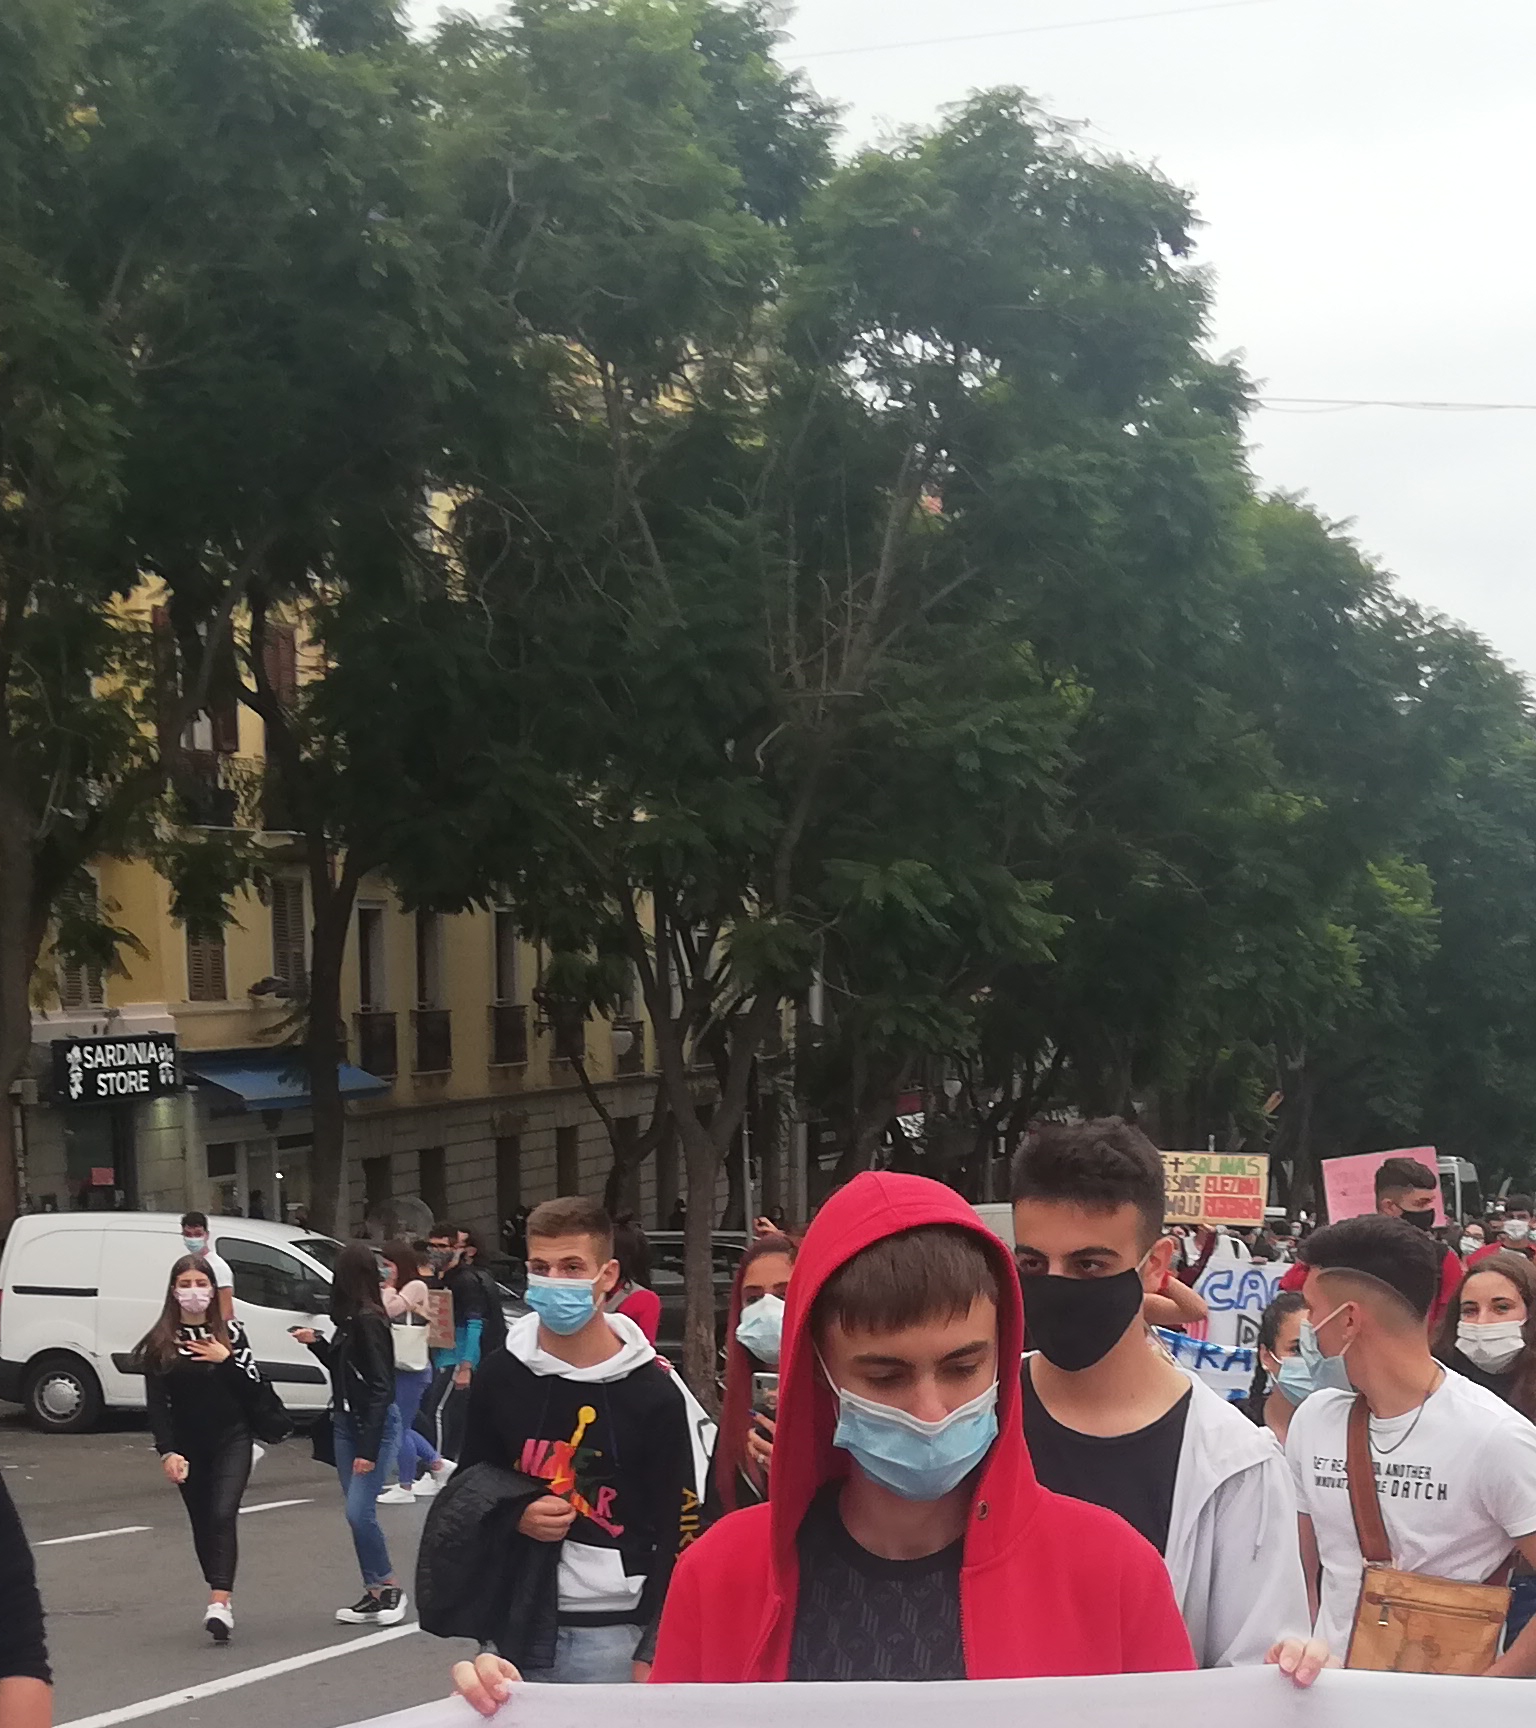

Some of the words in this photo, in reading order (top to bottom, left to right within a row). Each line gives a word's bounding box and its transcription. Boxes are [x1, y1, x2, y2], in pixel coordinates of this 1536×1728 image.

[82, 1041, 160, 1069] SARDINIA
[96, 1069, 150, 1097] STORE
[1384, 1463, 1432, 1480] ANOTHER
[1314, 1475, 1349, 1490] INNOVAT
[1390, 1479, 1449, 1501] DATCH
